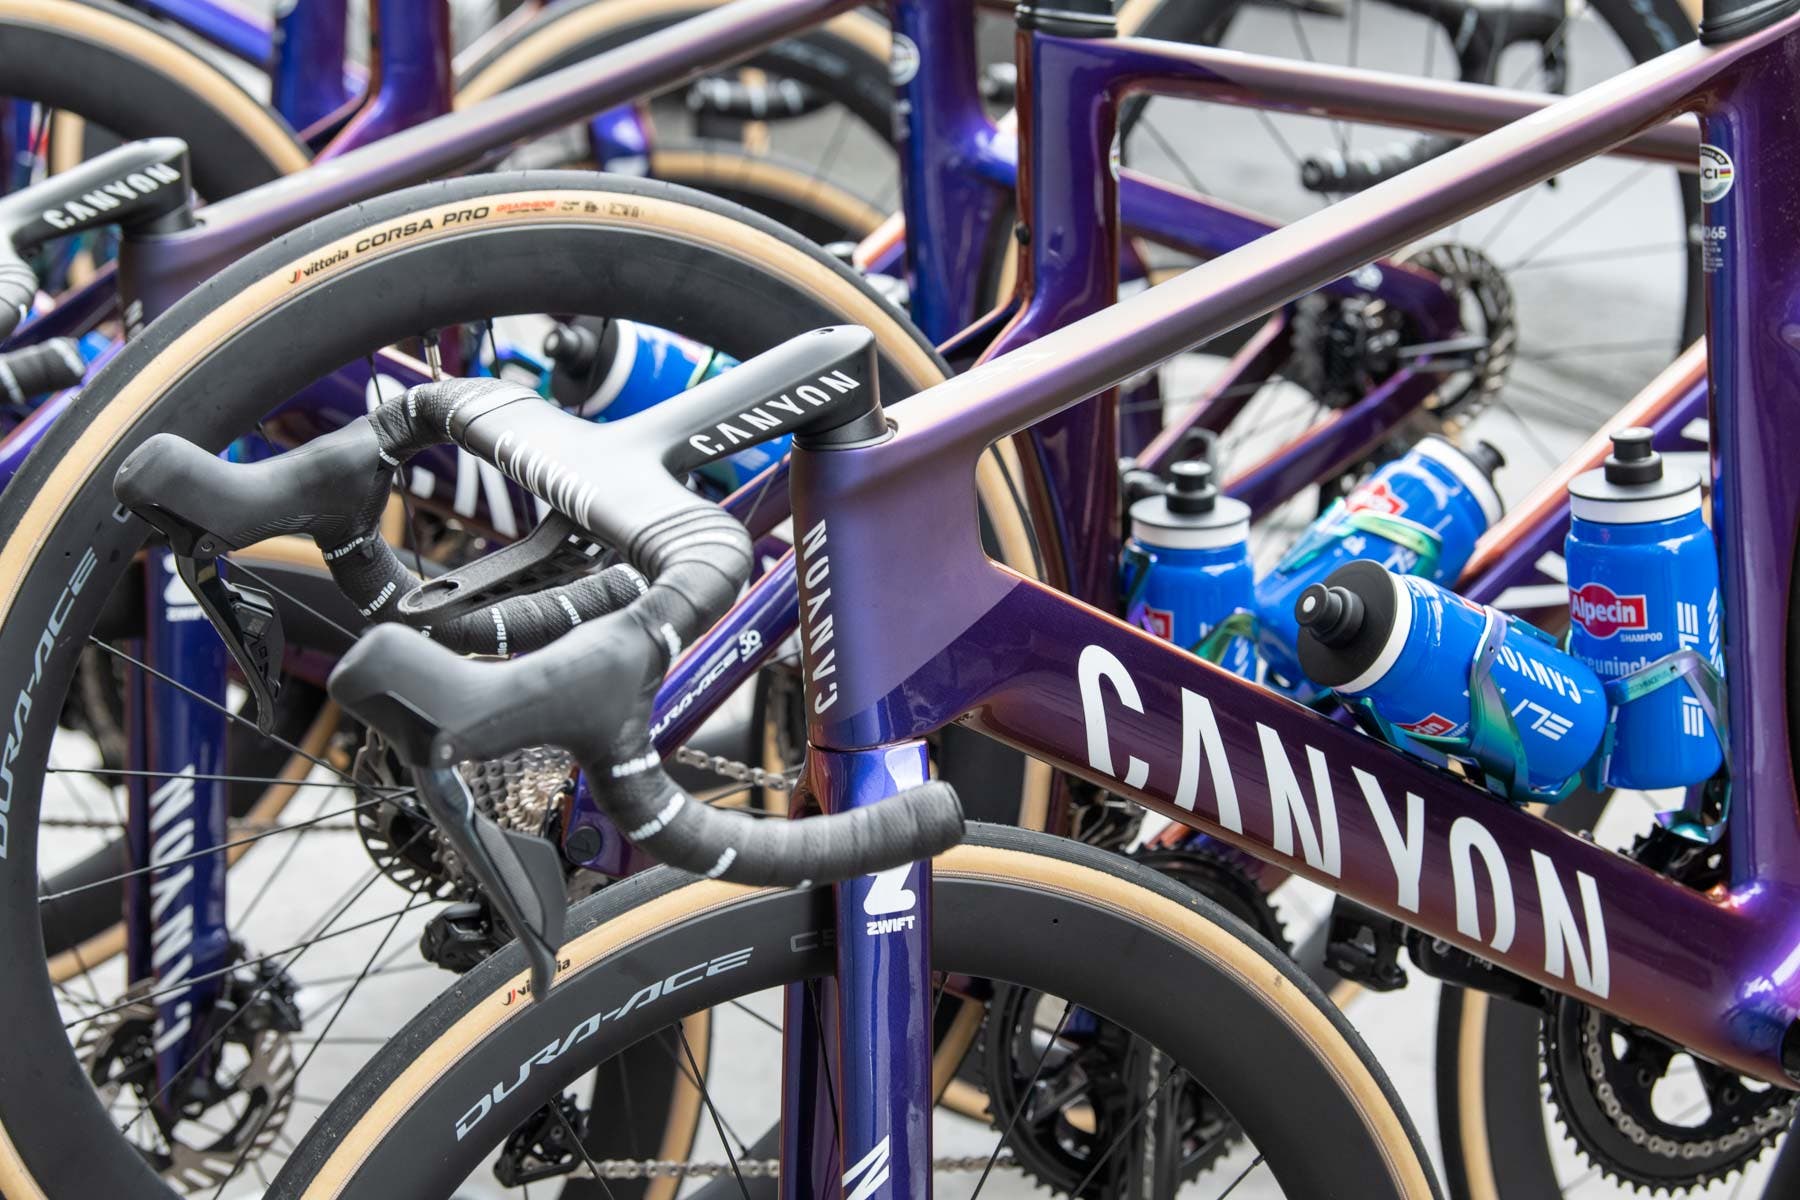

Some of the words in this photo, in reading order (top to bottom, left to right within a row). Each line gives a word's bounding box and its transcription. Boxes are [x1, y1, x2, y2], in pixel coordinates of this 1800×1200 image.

[43, 162, 181, 229] CANYON
[1700, 168, 1718, 180] CI
[303, 249, 349, 277] vittoria
[355, 218, 434, 254] CORSA
[442, 206, 490, 227] PRO
[689, 370, 860, 457] CANYON
[492, 428, 600, 530] CANYON
[802, 518, 839, 715] CANYON
[1572, 593, 1637, 626] Alpecin
[1619, 631, 1664, 643] SHAMPOO
[1077, 644, 1610, 1000] CANYON
[150, 763, 196, 1054] CANYON
[866, 915, 916, 936] ZWIFT
[517, 958, 571, 996] viia
[456, 947, 754, 1142] DURA-ACE
